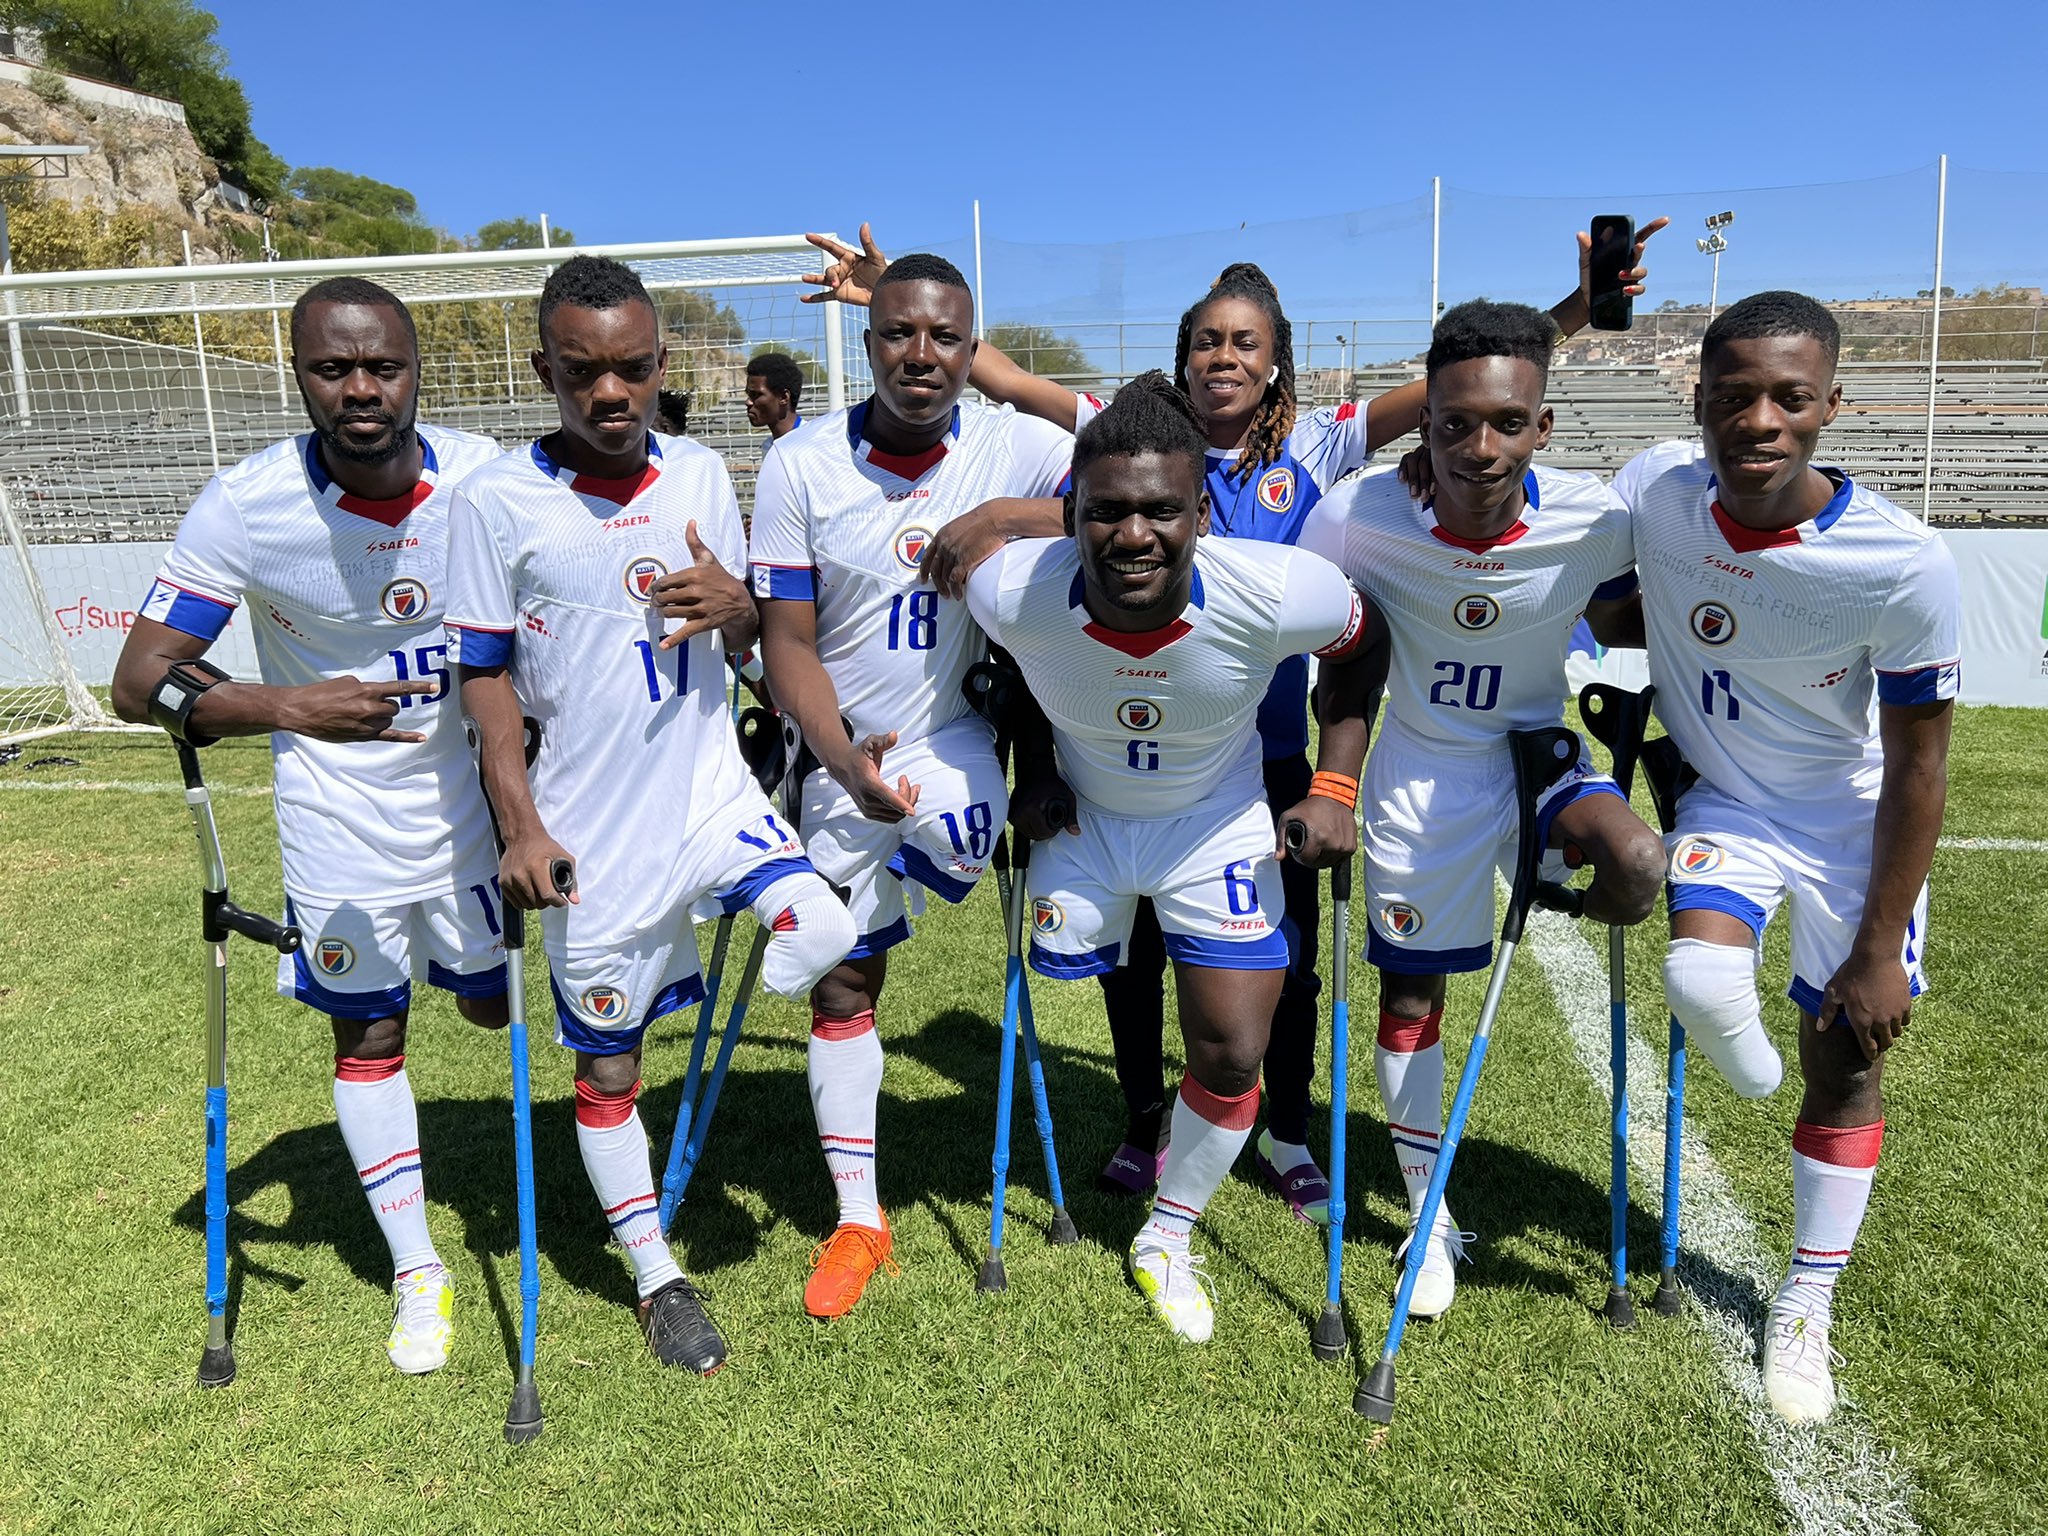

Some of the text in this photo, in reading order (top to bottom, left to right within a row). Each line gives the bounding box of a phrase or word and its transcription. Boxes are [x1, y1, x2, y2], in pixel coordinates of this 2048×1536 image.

[897, 489, 930, 501] SAETA
[614, 514, 651, 529] SAETA
[378, 536, 419, 551] SAETA
[1464, 560, 1506, 571] SAETA
[1714, 558, 1755, 580] SAETA
[887, 590, 940, 651] 18
[388, 644, 451, 709] 15
[633, 634, 690, 703] 17
[1127, 668, 1169, 679] SAETA
[1429, 660, 1503, 711] 20
[1126, 739, 1160, 771] 6
[938, 800, 993, 861] 18
[1223, 859, 1259, 916] 6
[1230, 920, 1265, 931] SAETA
